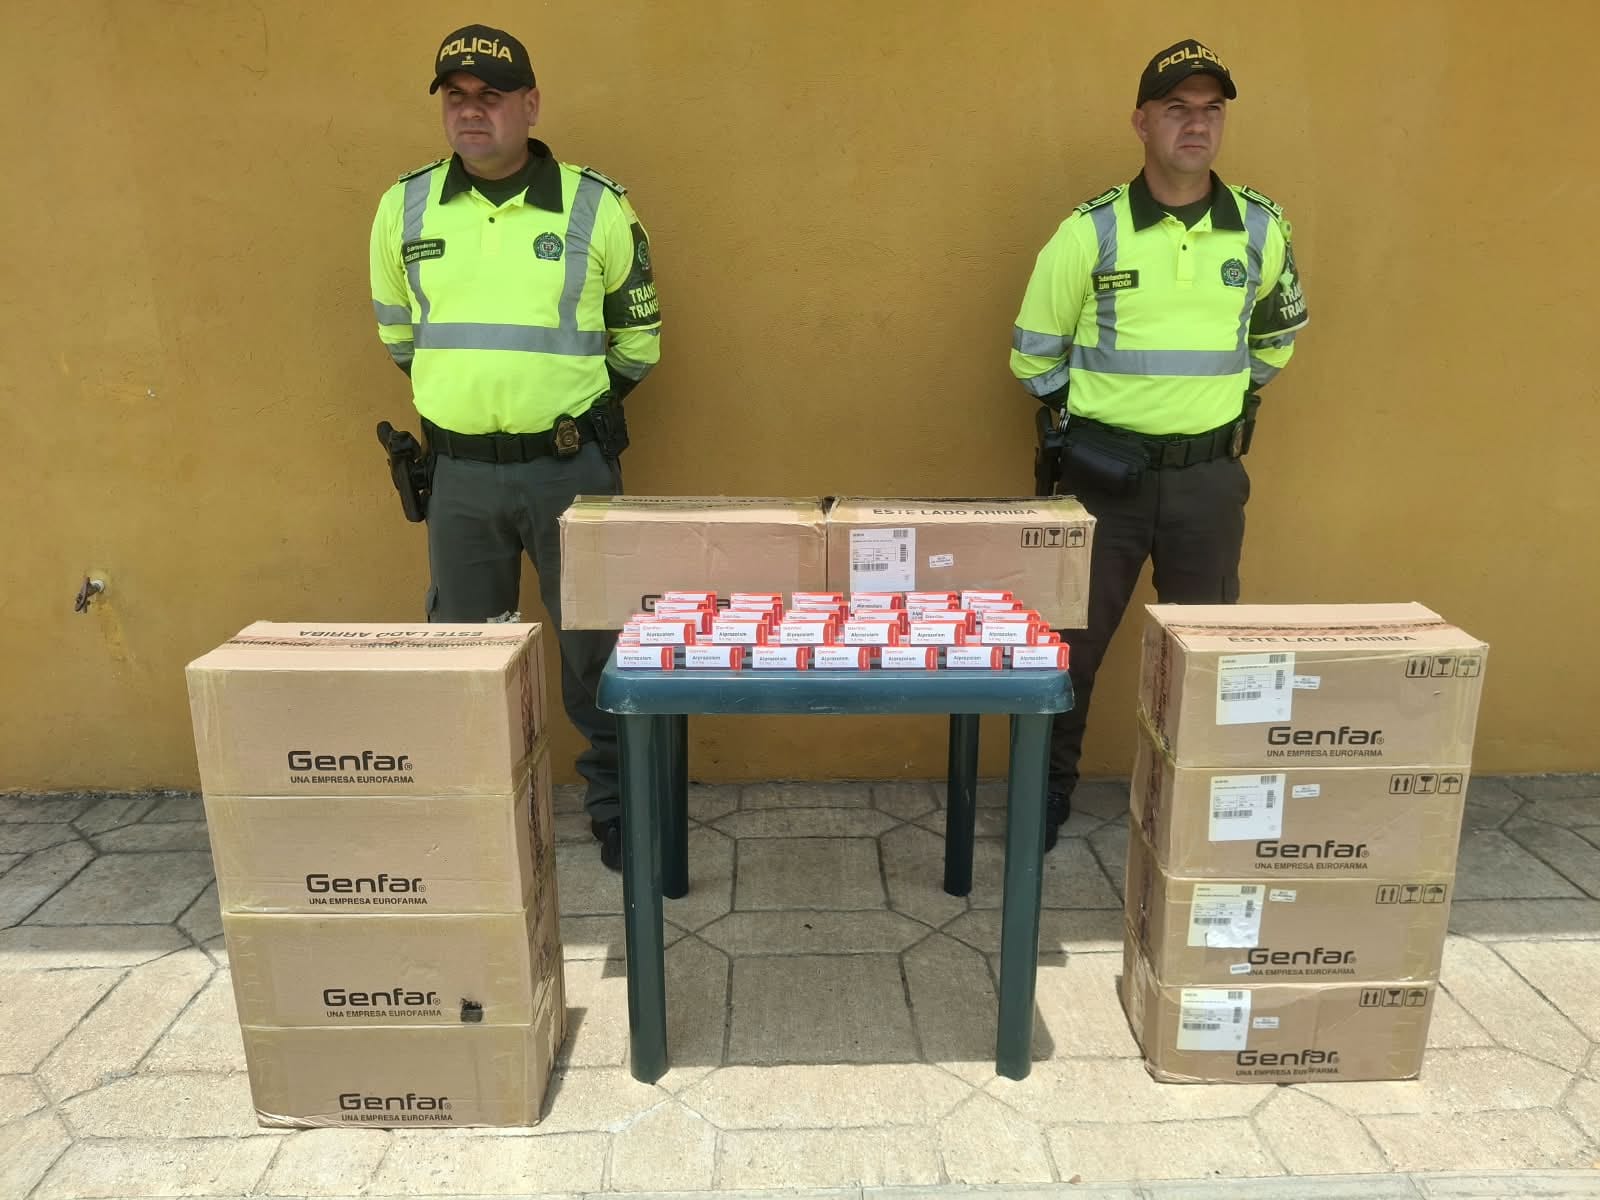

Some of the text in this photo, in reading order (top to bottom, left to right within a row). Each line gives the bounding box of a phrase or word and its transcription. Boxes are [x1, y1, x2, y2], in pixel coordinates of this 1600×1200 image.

[440, 37, 512, 63] POLICÍA
[1330, 749, 1383, 757] EUROFARMA
[290, 776, 414, 784] UNA EMPRESA EUROFARMA
[373, 897, 428, 905] EUROFARMA
[346, 1010, 386, 1018] EMPRESA
[389, 1009, 442, 1017] EUROFARMA
[342, 1114, 358, 1122] UNA
